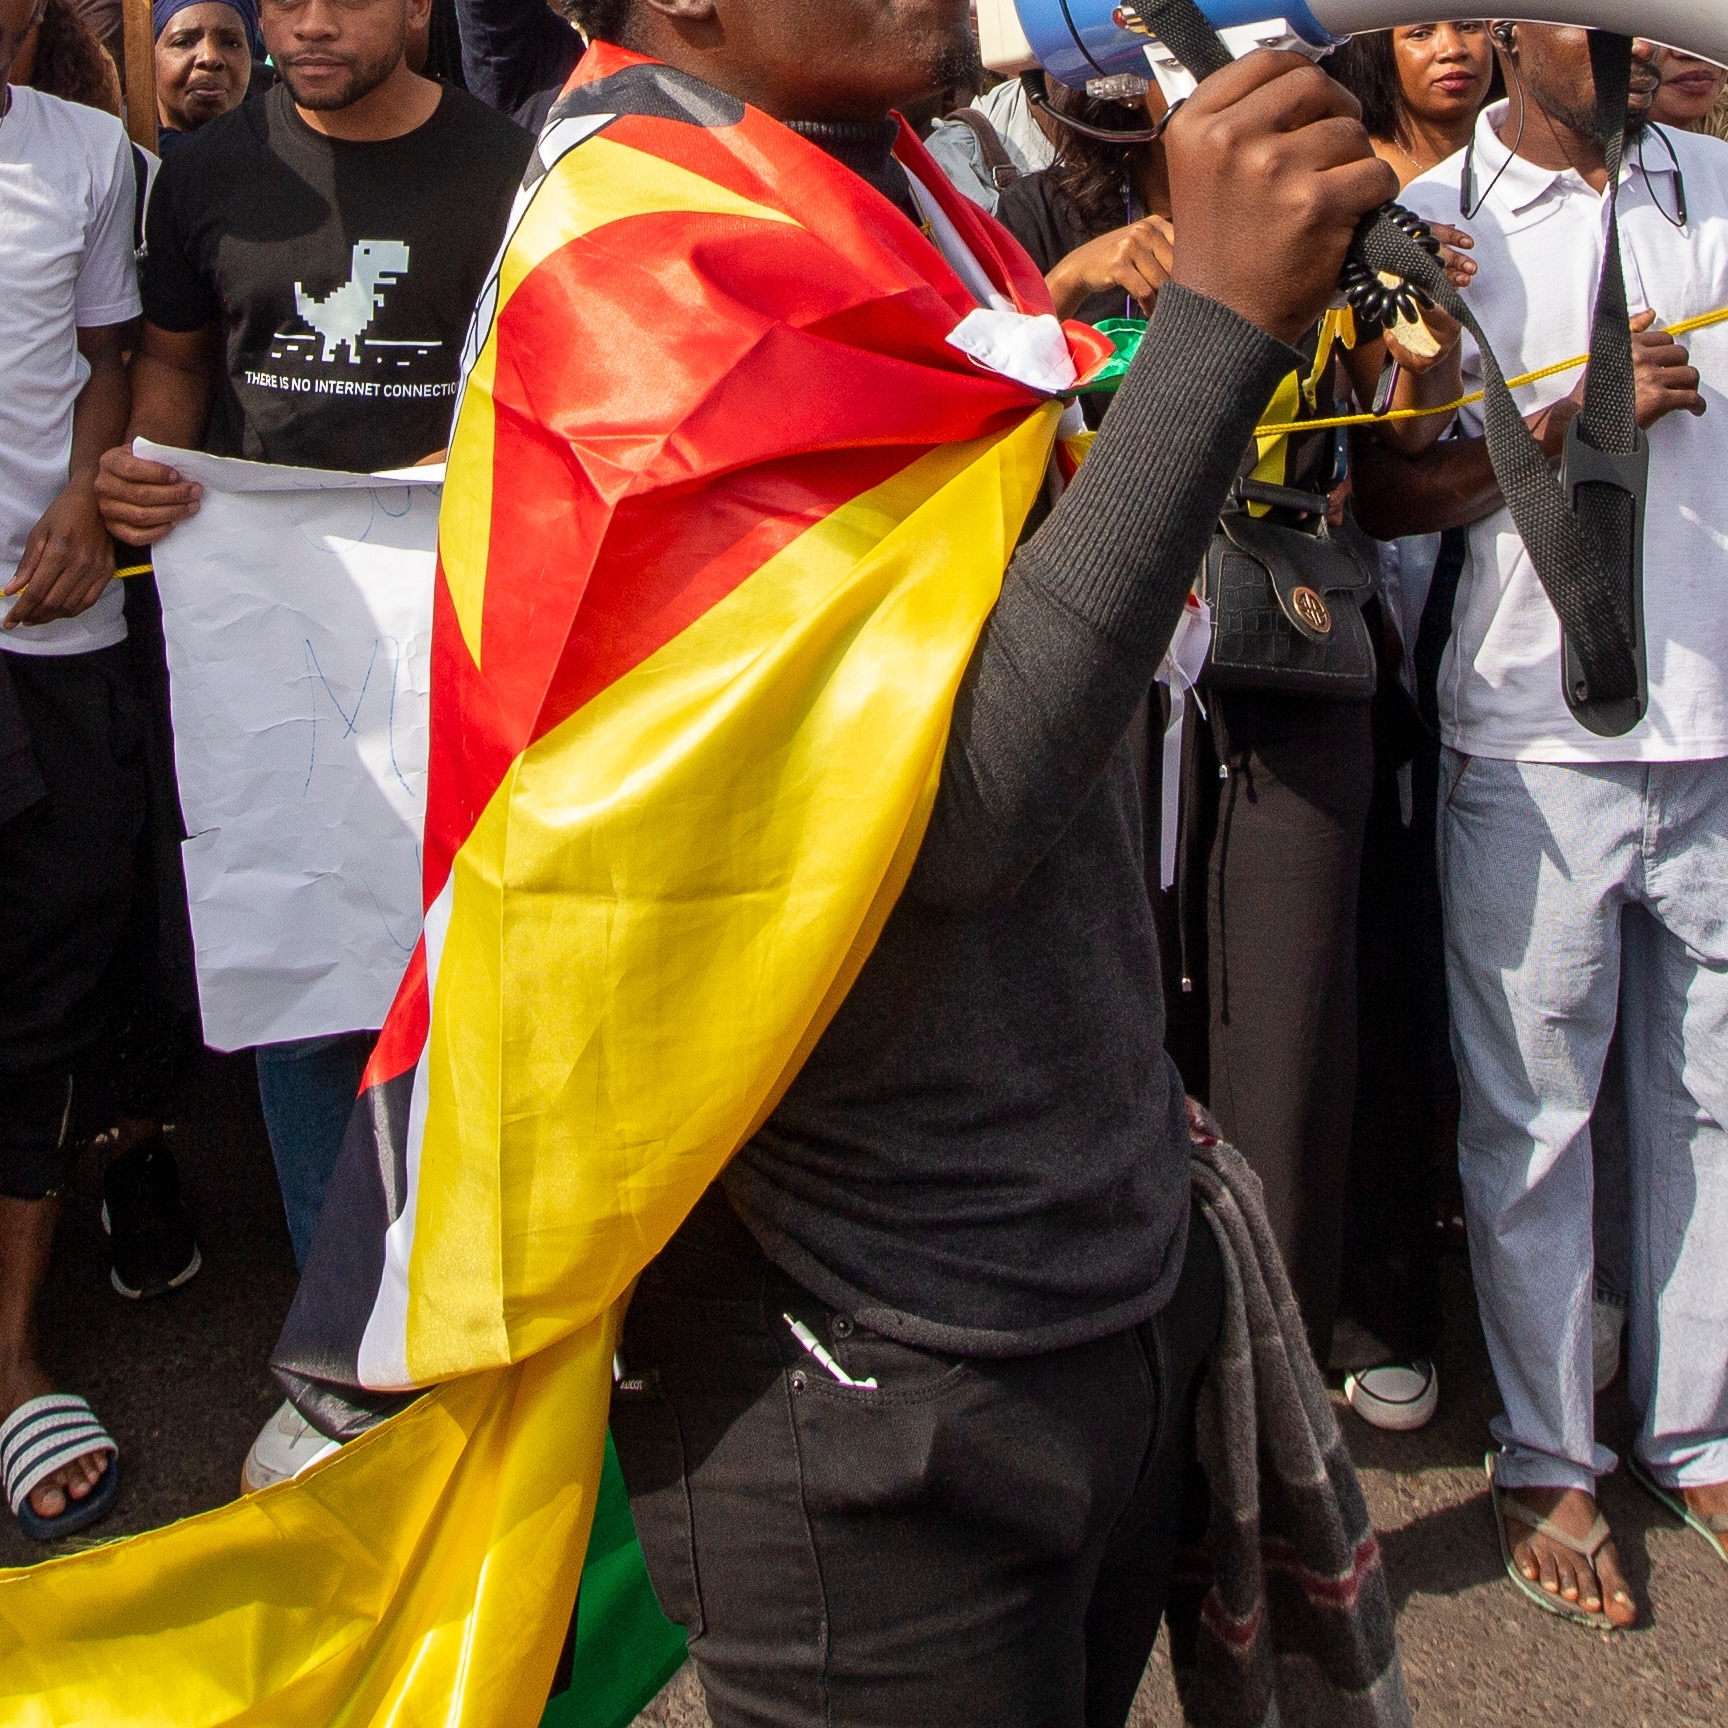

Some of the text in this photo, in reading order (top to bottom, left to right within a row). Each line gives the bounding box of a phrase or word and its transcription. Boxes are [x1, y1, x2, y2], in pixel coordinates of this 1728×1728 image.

[245, 370, 278, 388] THERE
[278, 375, 290, 390] IS
[291, 377, 312, 393] NO
[314, 378, 382, 397] INTERNET
